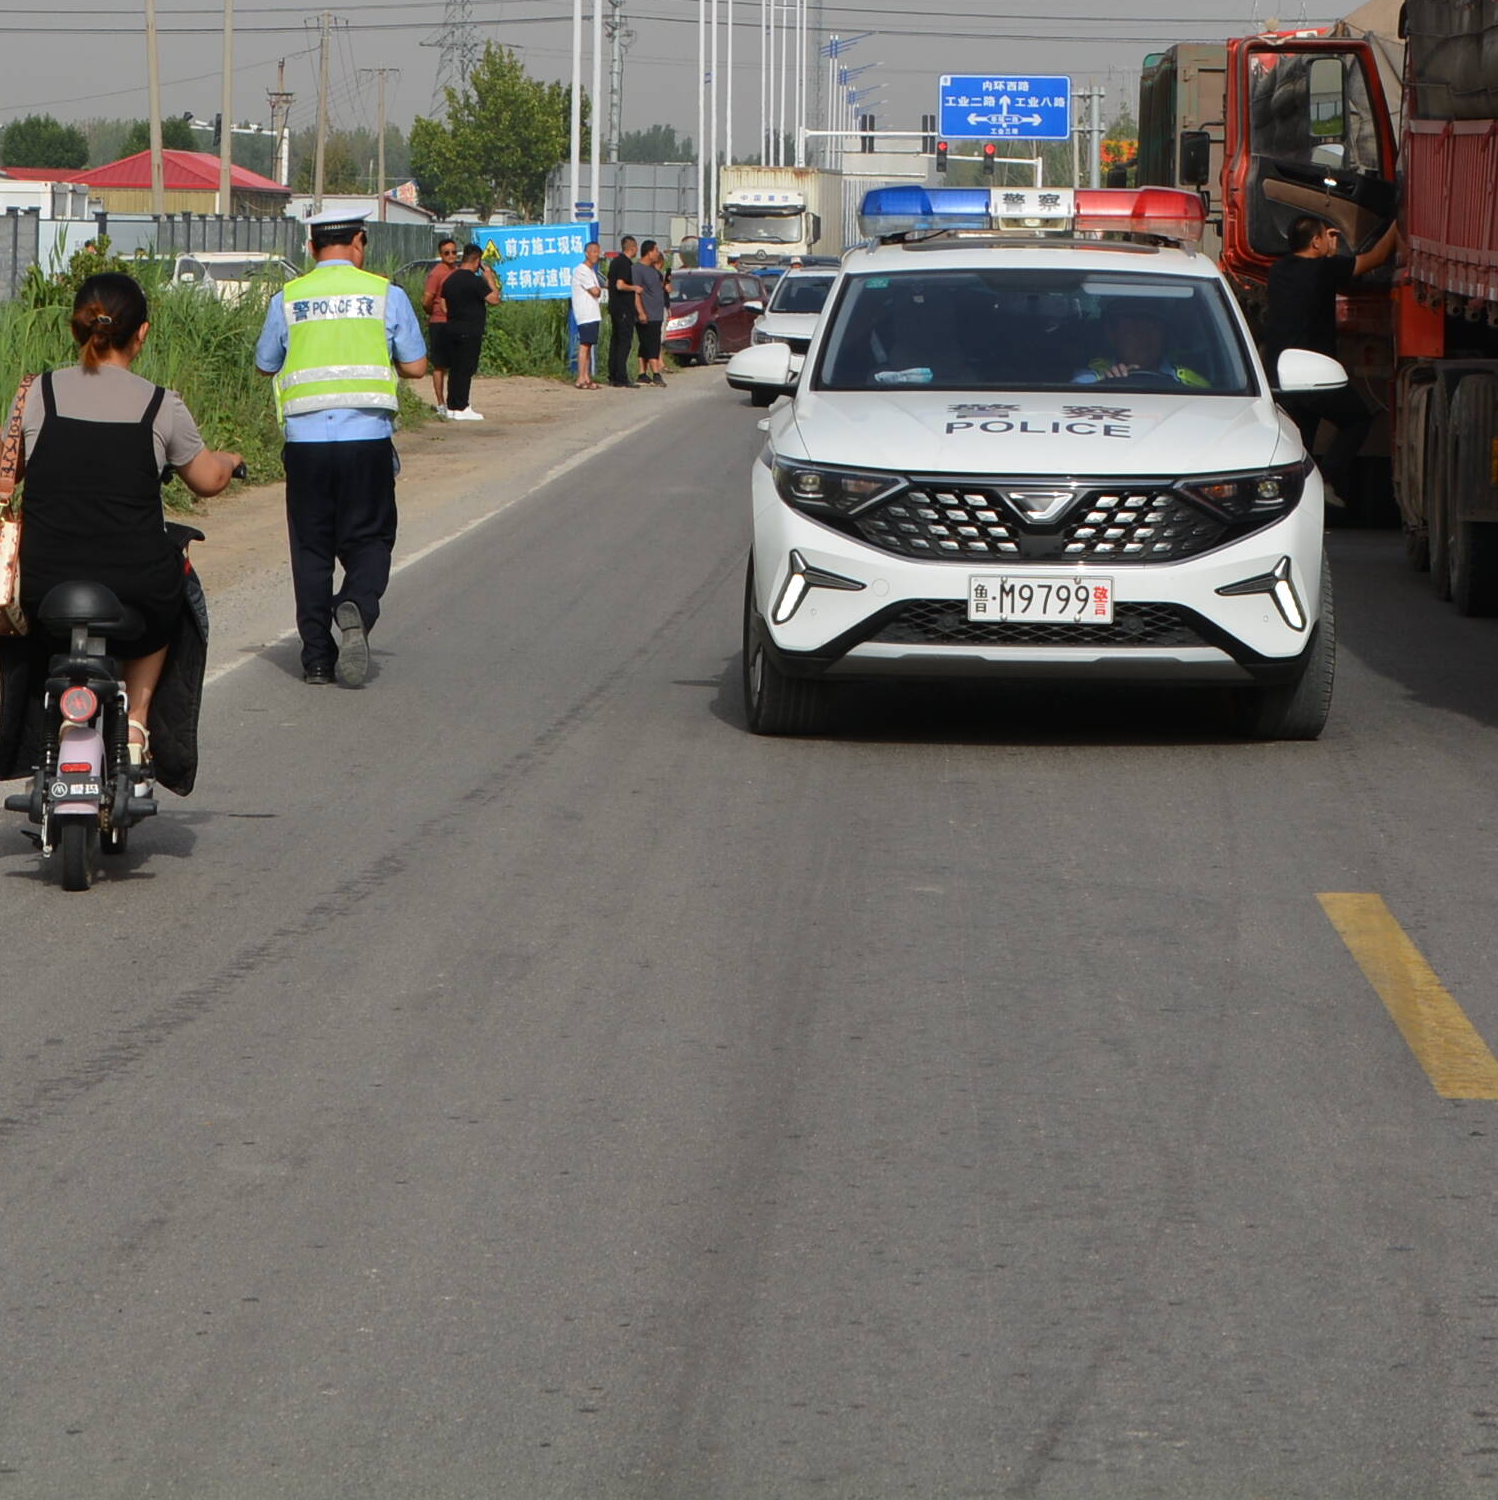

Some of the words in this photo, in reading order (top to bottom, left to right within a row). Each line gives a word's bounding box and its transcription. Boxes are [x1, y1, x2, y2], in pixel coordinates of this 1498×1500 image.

[982, 81, 1029, 92] 内环西路
[944, 96, 996, 107] 工业二路
[1015, 97, 1065, 108] 工业八路
[1002, 193, 1061, 213] 警察
[504, 236, 582, 258] 前方施工现场
[945, 421, 1132, 438] POLICE
